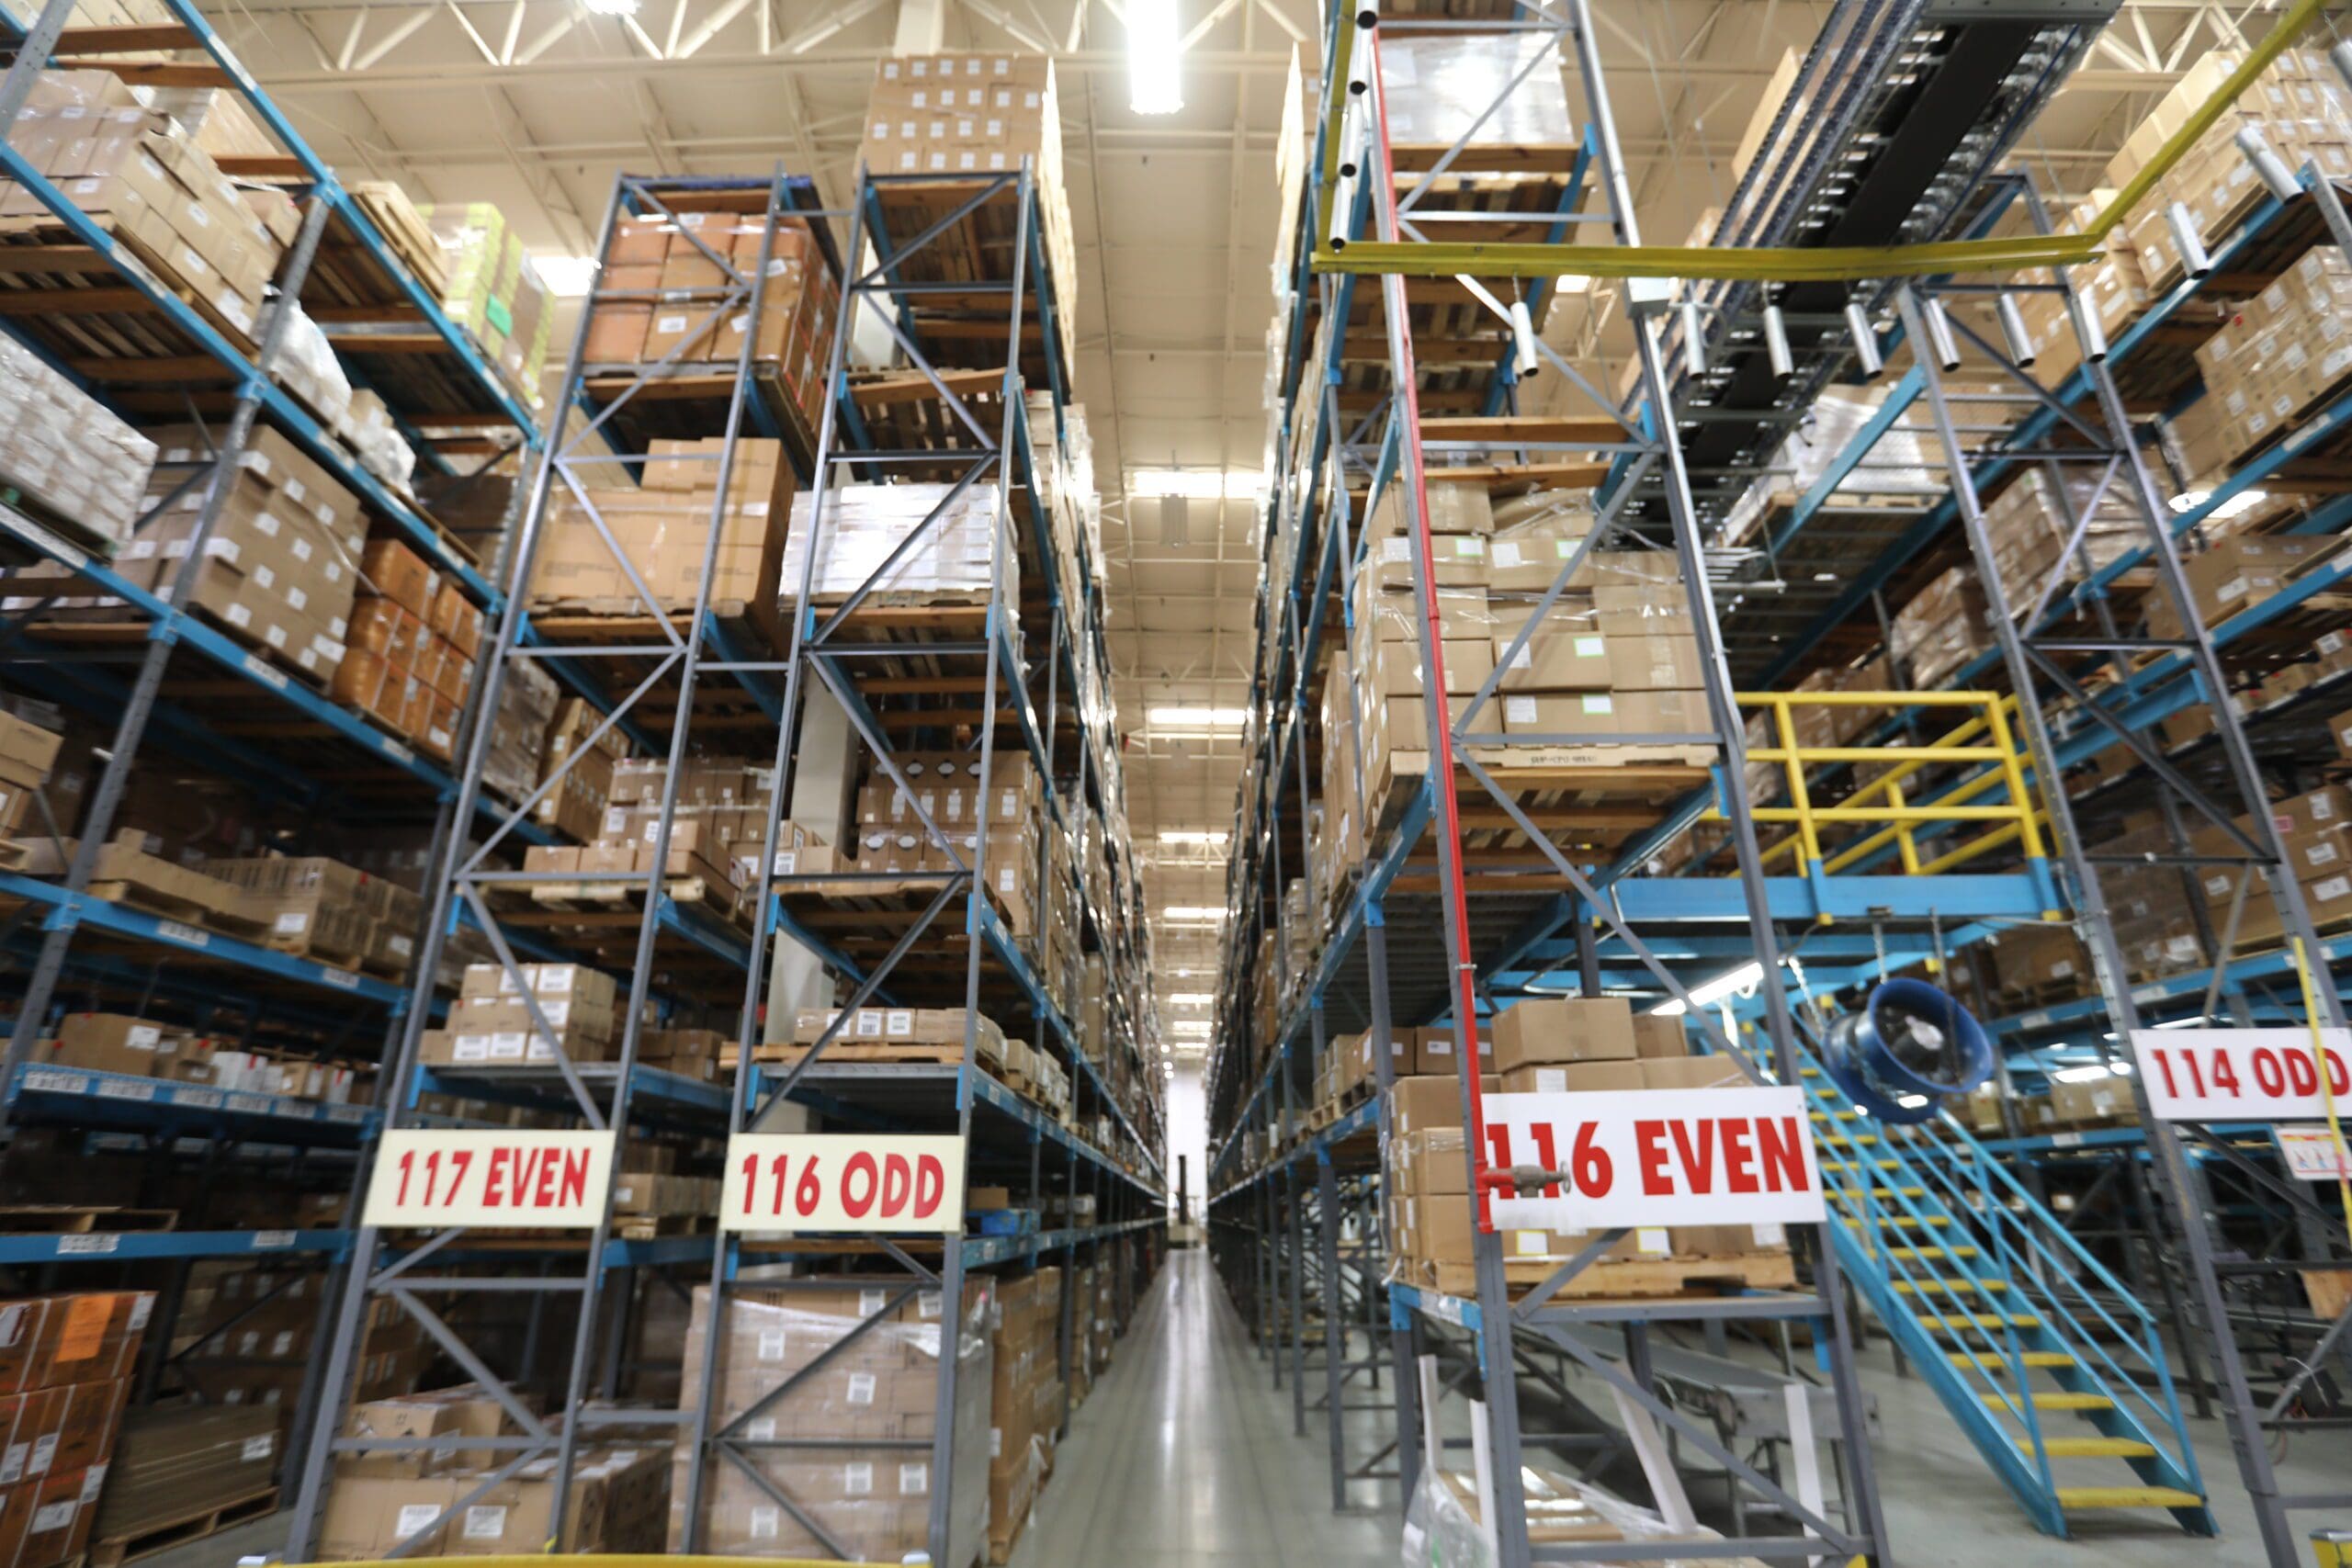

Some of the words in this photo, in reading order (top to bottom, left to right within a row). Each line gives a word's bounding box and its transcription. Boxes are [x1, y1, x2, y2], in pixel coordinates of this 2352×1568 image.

[2151, 1048, 2241, 1099] 114
[2251, 1046, 2350, 1099] ODD
[396, 1150, 473, 1206] 117
[481, 1147, 591, 1207] EVEN
[742, 1154, 820, 1217] 116
[841, 1151, 944, 1219] ODD
[1486, 1121, 1613, 1200] 116
[1634, 1116, 1810, 1196] EVEN
